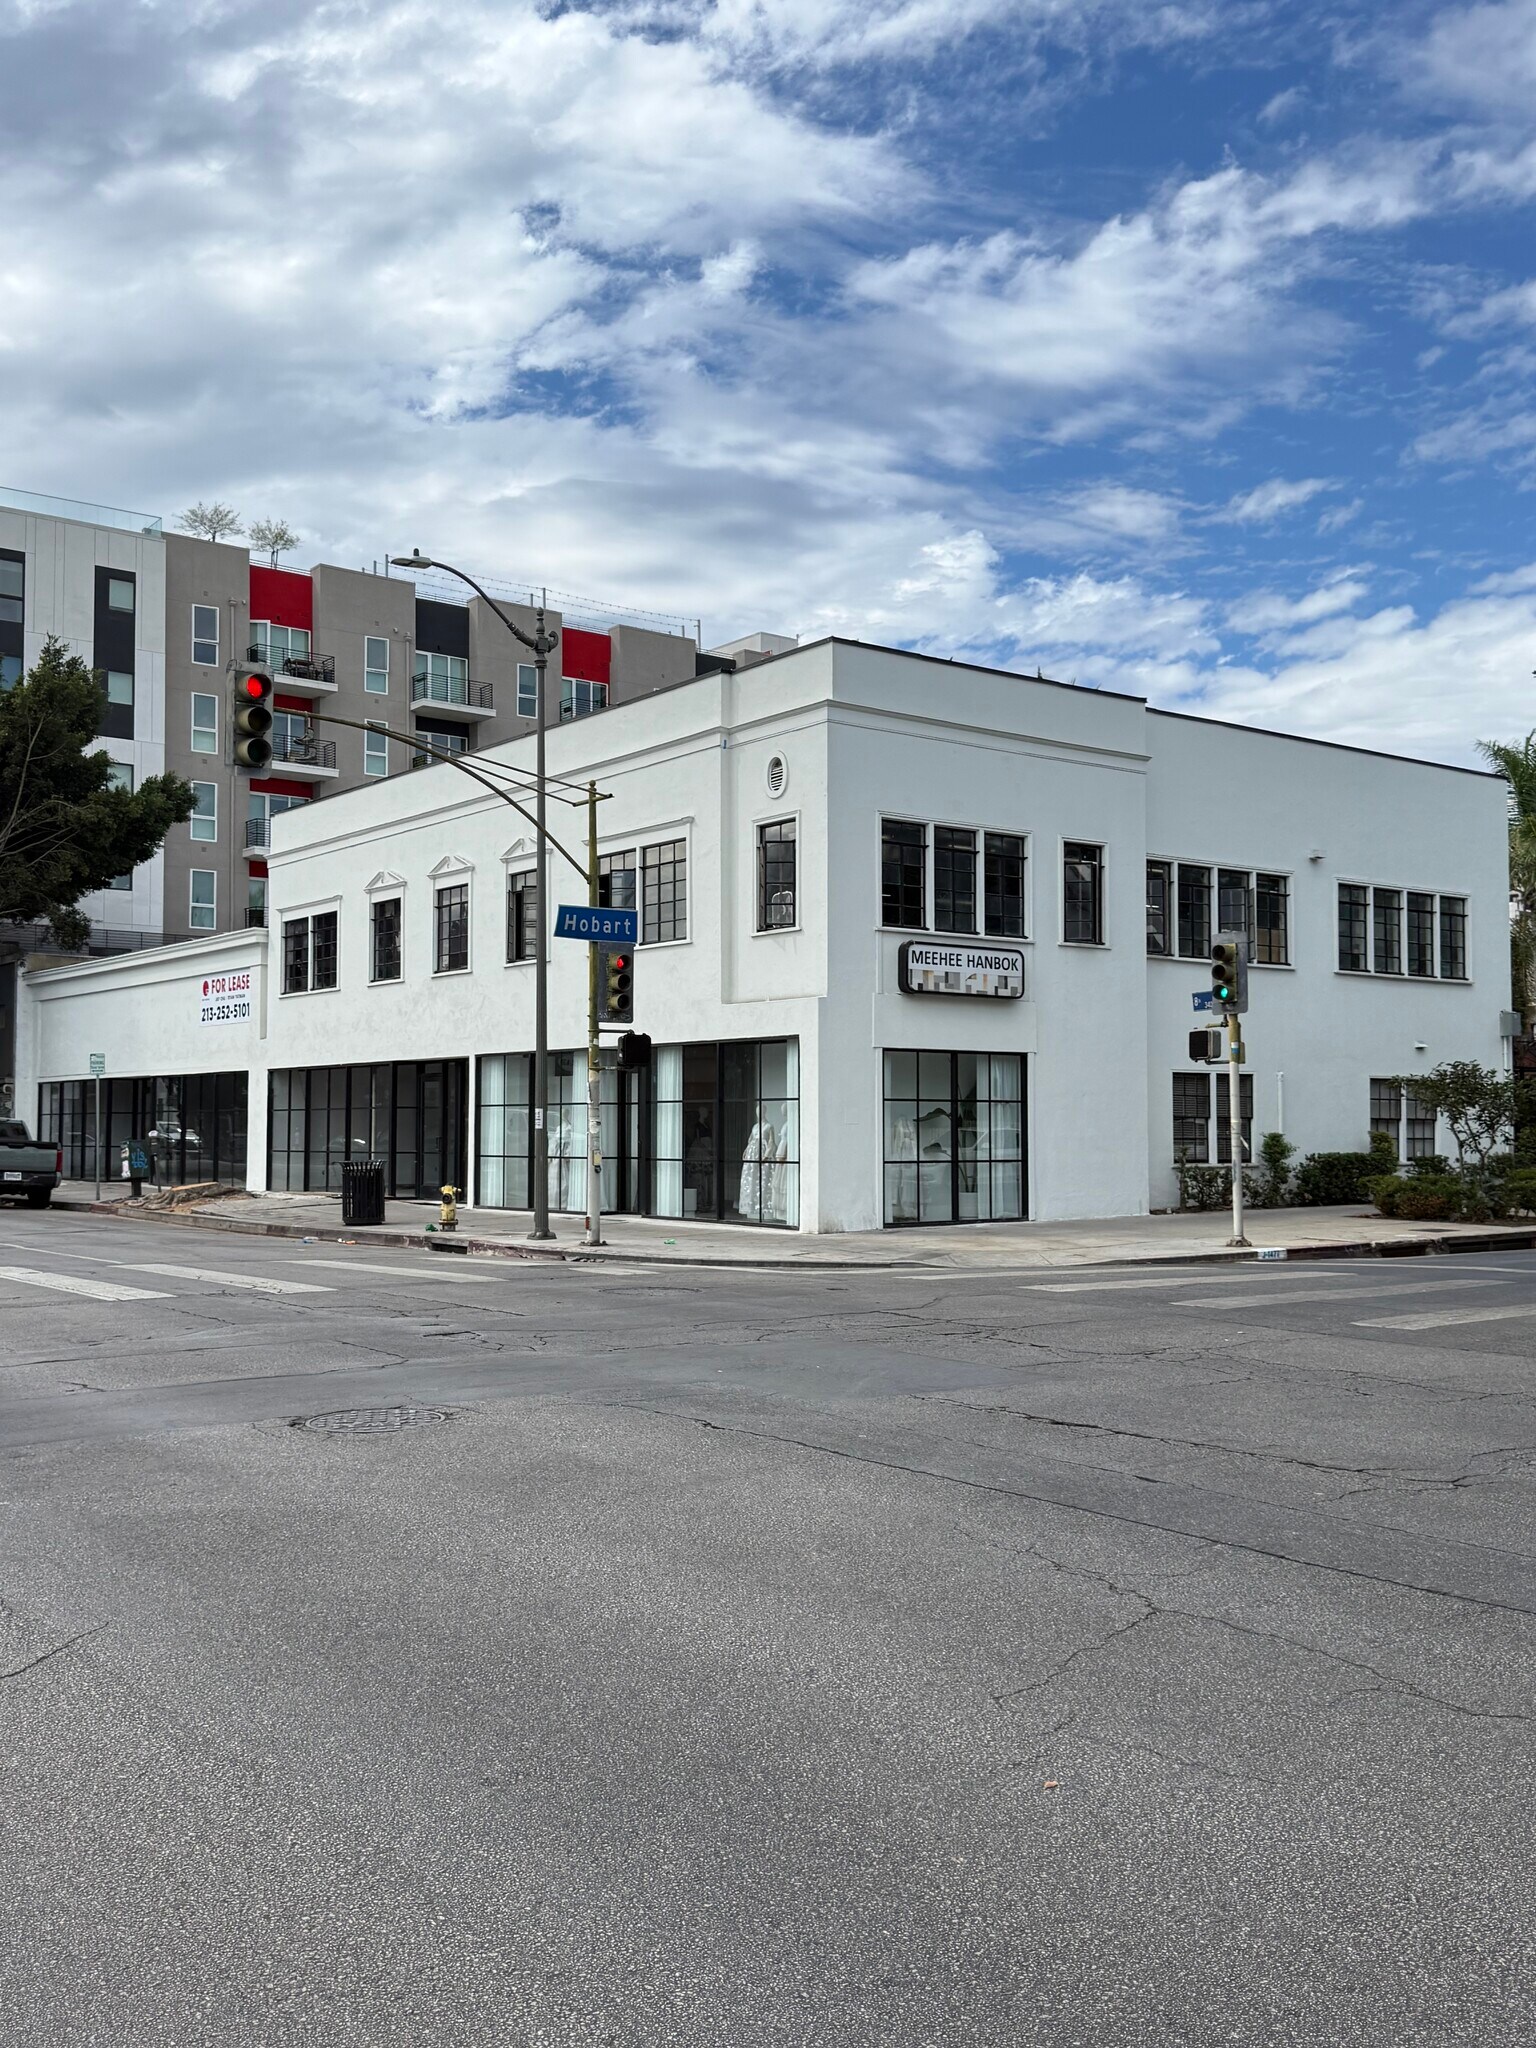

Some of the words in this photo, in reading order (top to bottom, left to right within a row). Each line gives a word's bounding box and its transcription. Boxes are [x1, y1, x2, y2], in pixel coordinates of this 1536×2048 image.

[564, 914, 630, 934] Hobart
[911, 950, 962, 967] MEEHEE
[967, 954, 1019, 971] HANBOK
[211, 978, 226, 994] FOR
[228, 974, 250, 992] LEASE
[201, 1002, 250, 1022] 213-252-5101
